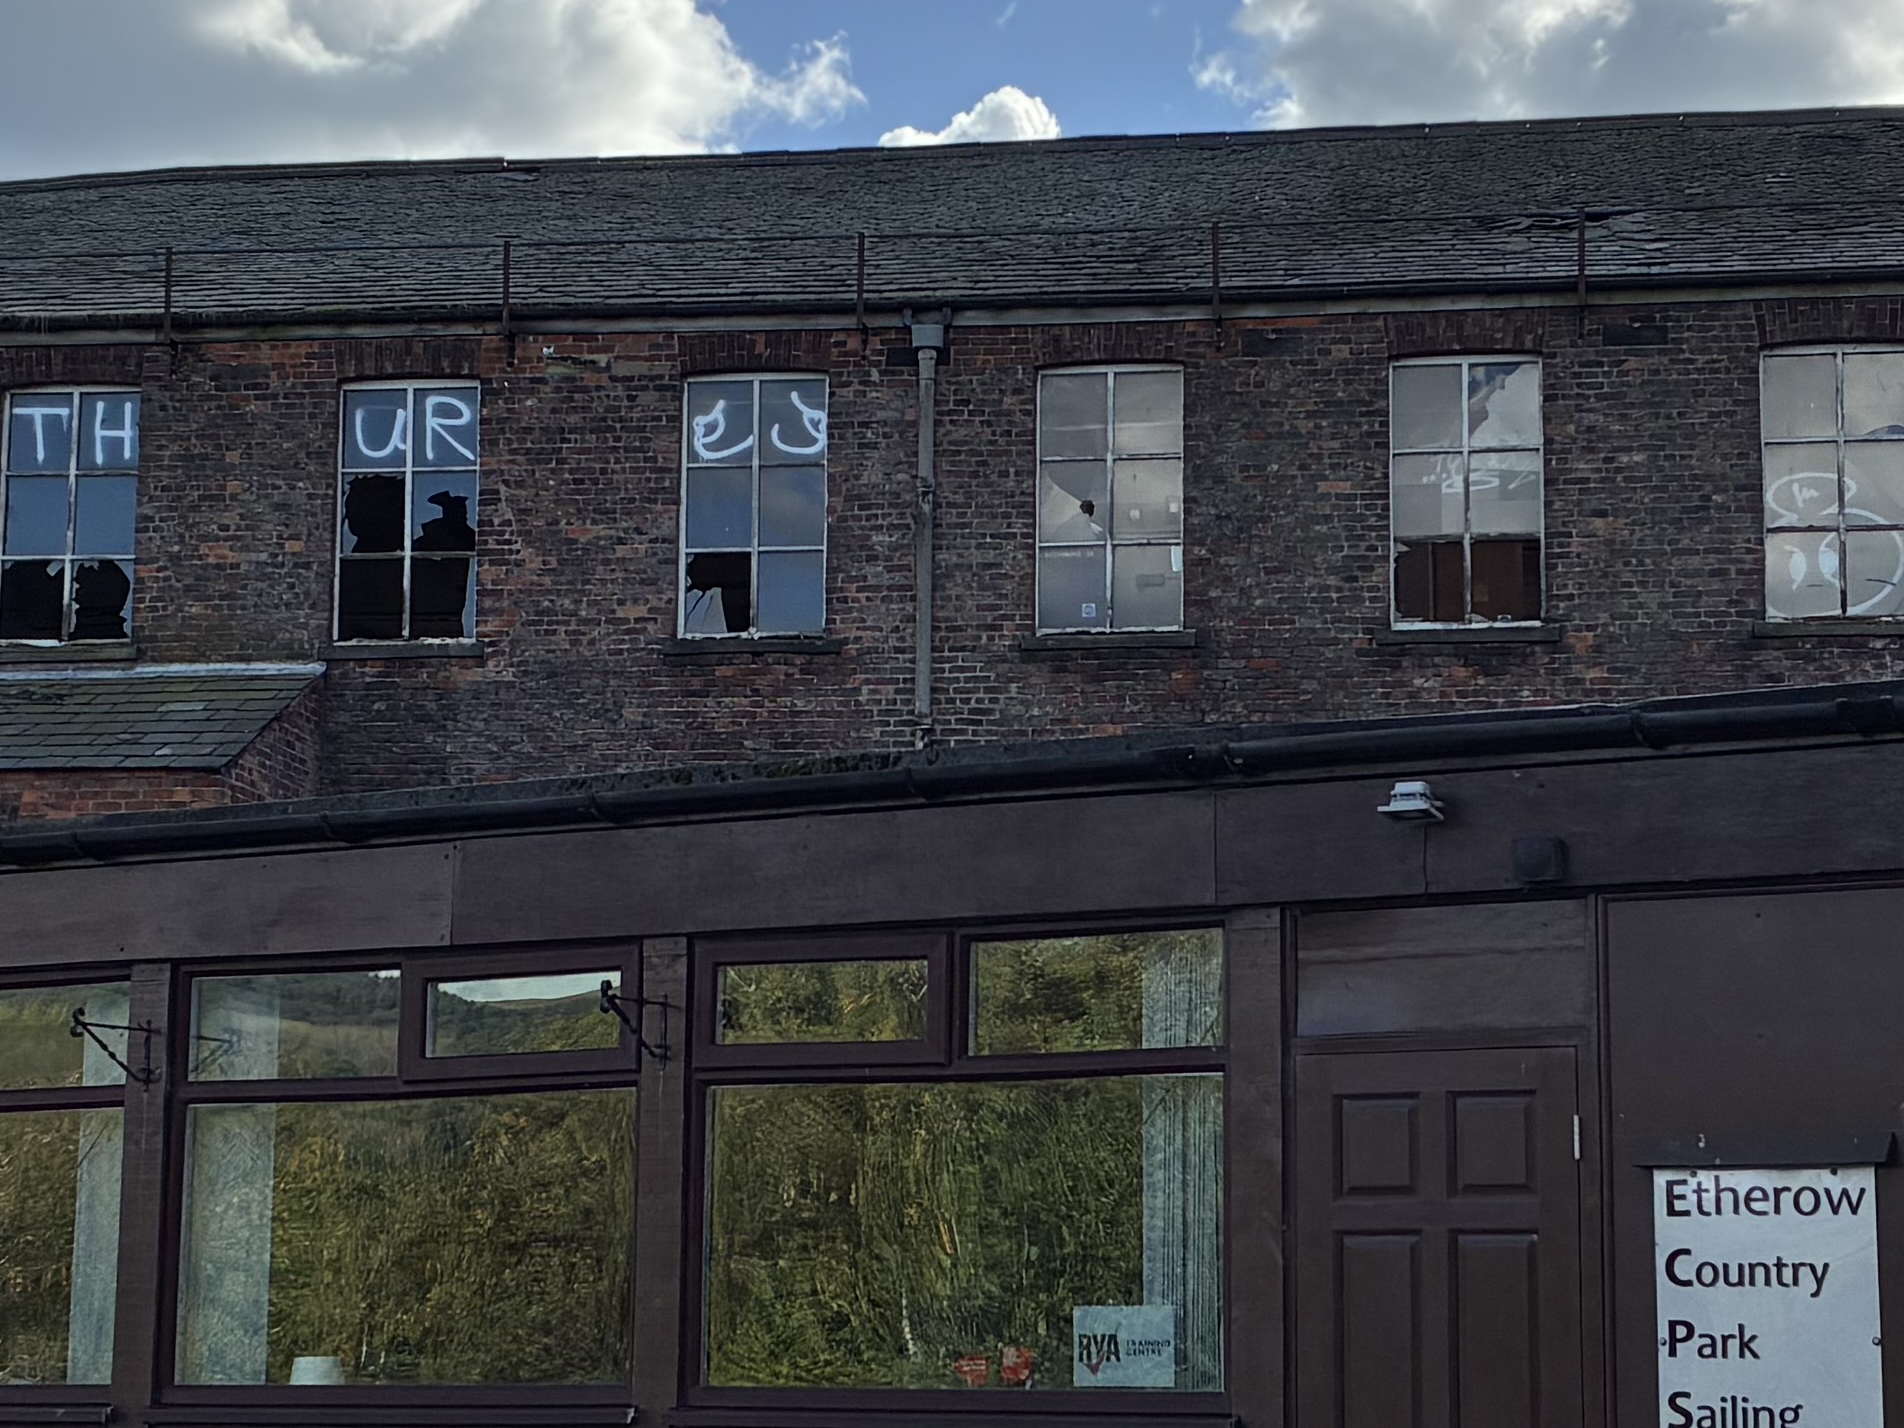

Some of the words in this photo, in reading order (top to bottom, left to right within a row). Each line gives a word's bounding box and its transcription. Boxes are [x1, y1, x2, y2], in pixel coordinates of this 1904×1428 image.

[1665, 1174, 1867, 1218] Etherow
[1664, 1248, 1830, 1298] Country
[1667, 1319, 1761, 1360] Park
